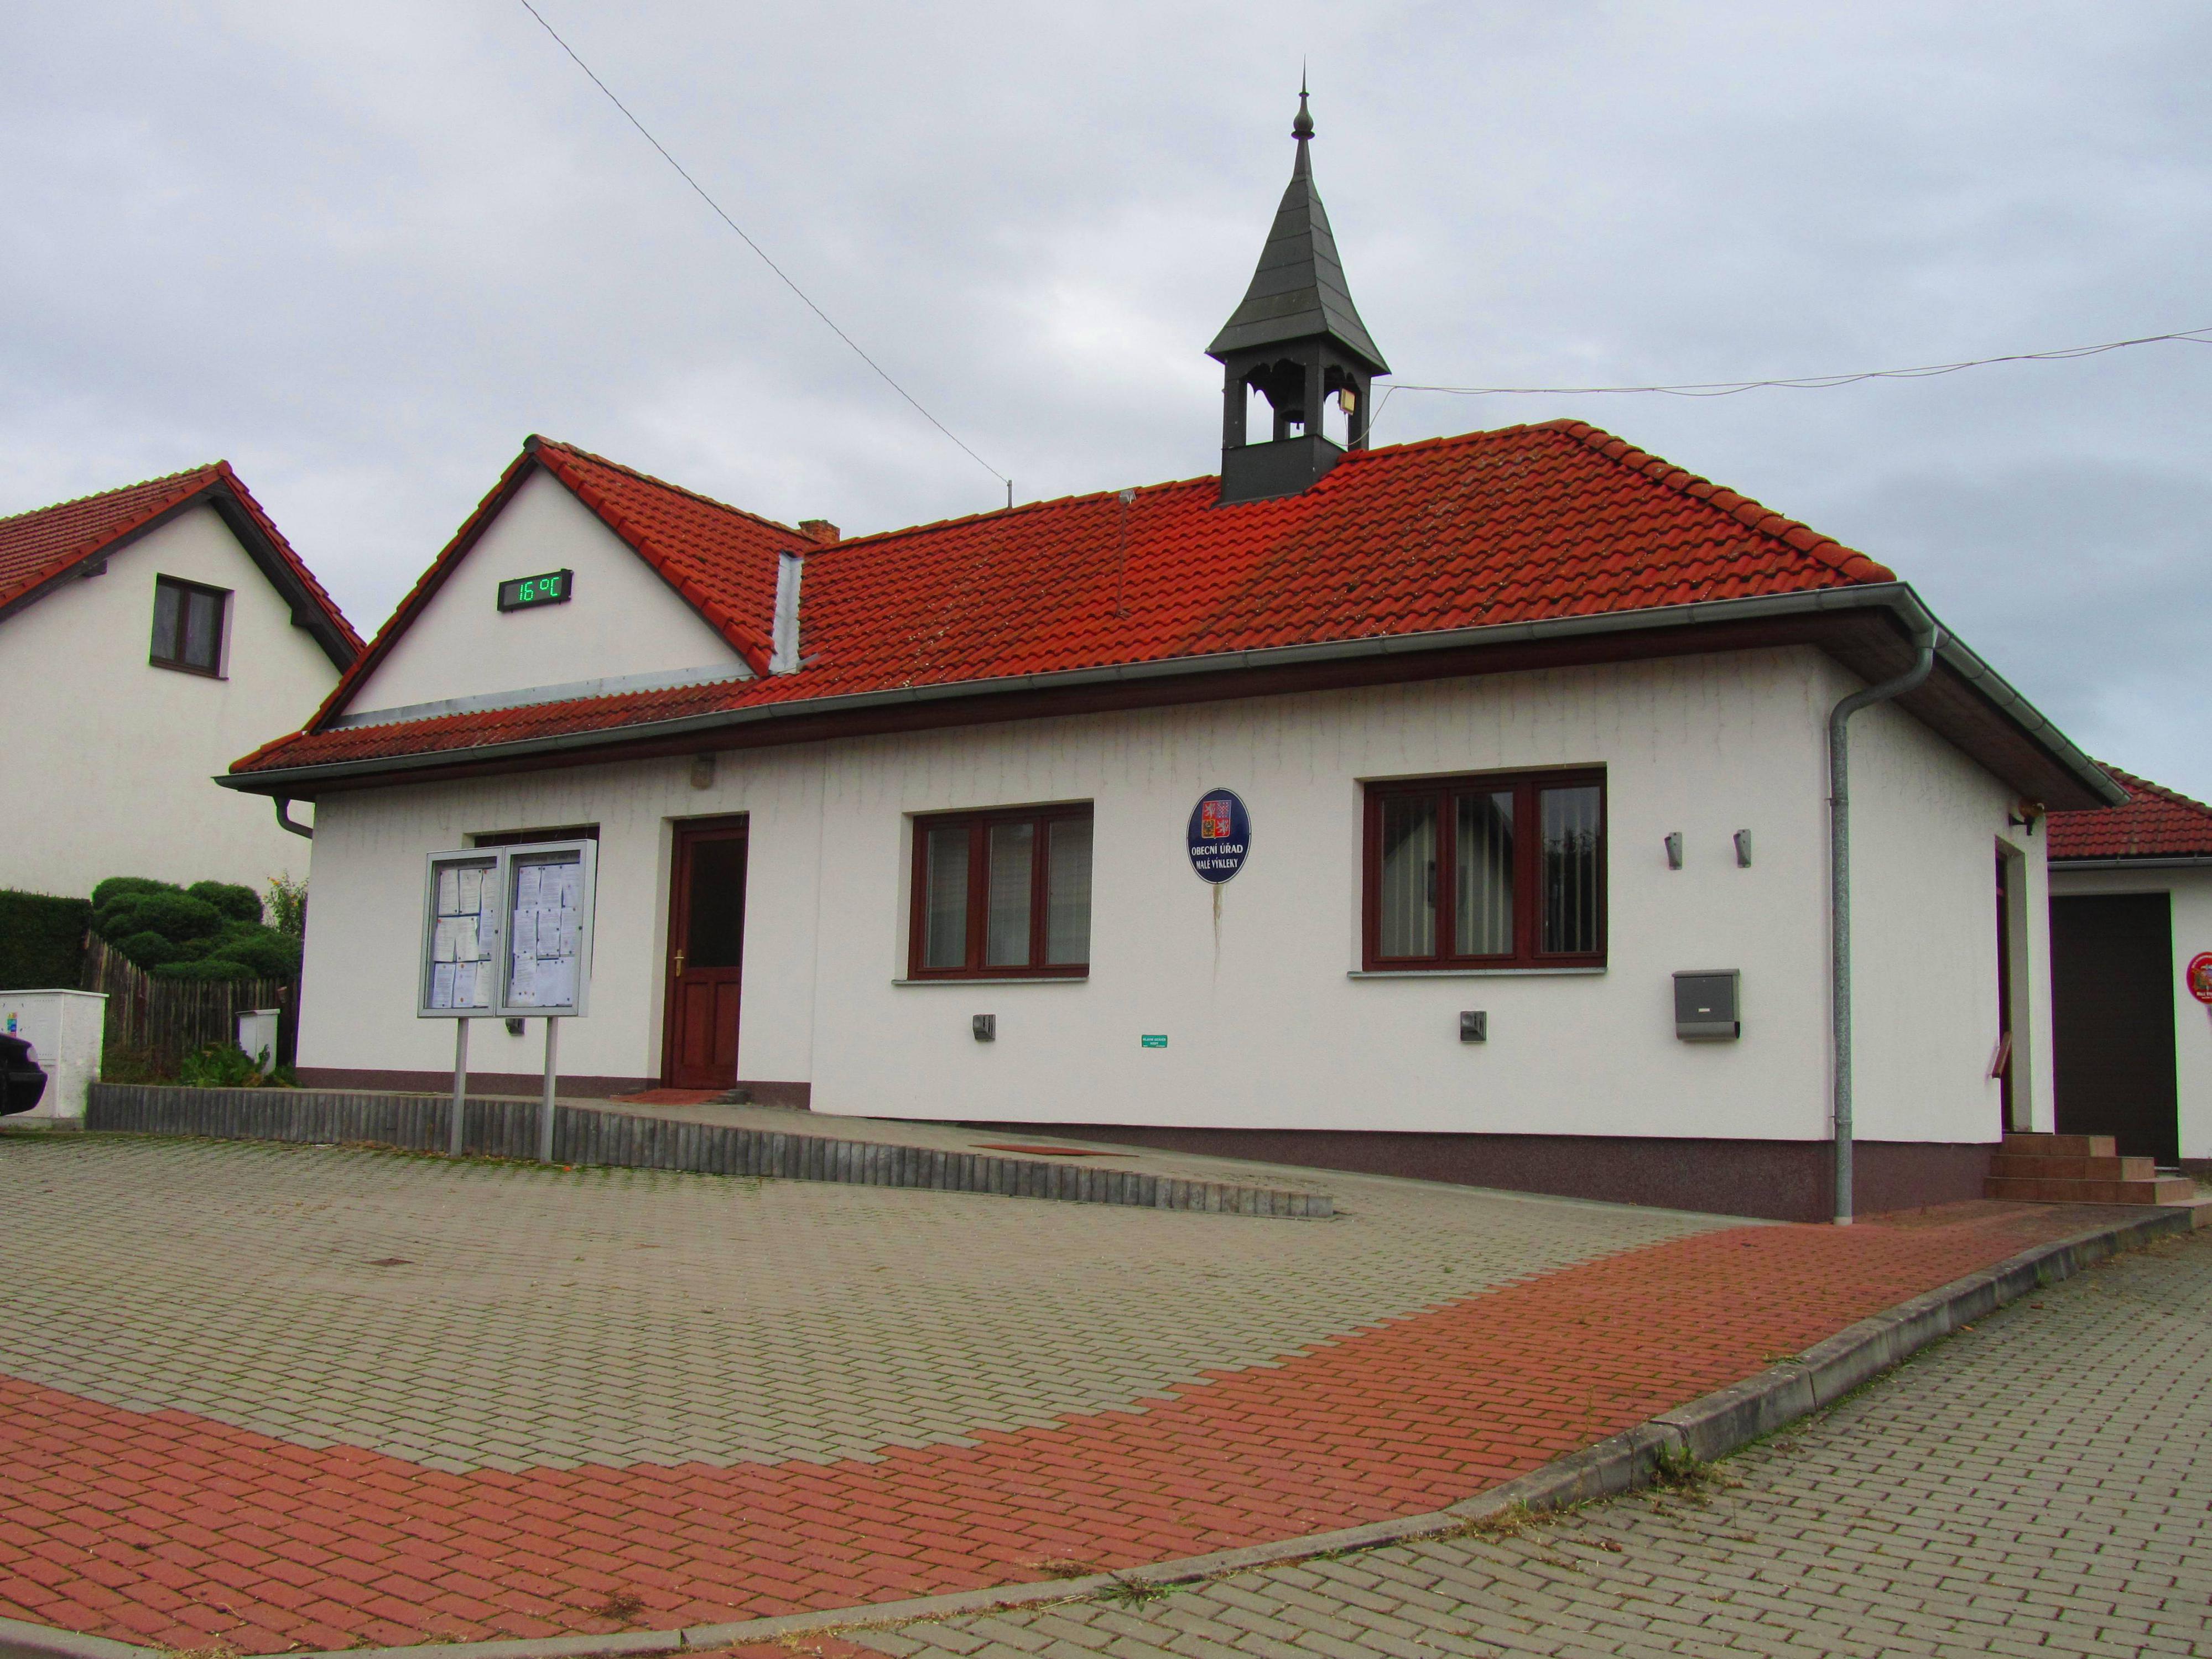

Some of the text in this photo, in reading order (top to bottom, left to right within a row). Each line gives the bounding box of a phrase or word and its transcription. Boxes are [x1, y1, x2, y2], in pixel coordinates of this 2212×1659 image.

[520, 582, 534, 601] 16
[1191, 842, 1243, 855] OBECNÍ ÚŘAD
[1196, 857, 1238, 869] MALÉ VÝKLEKY
